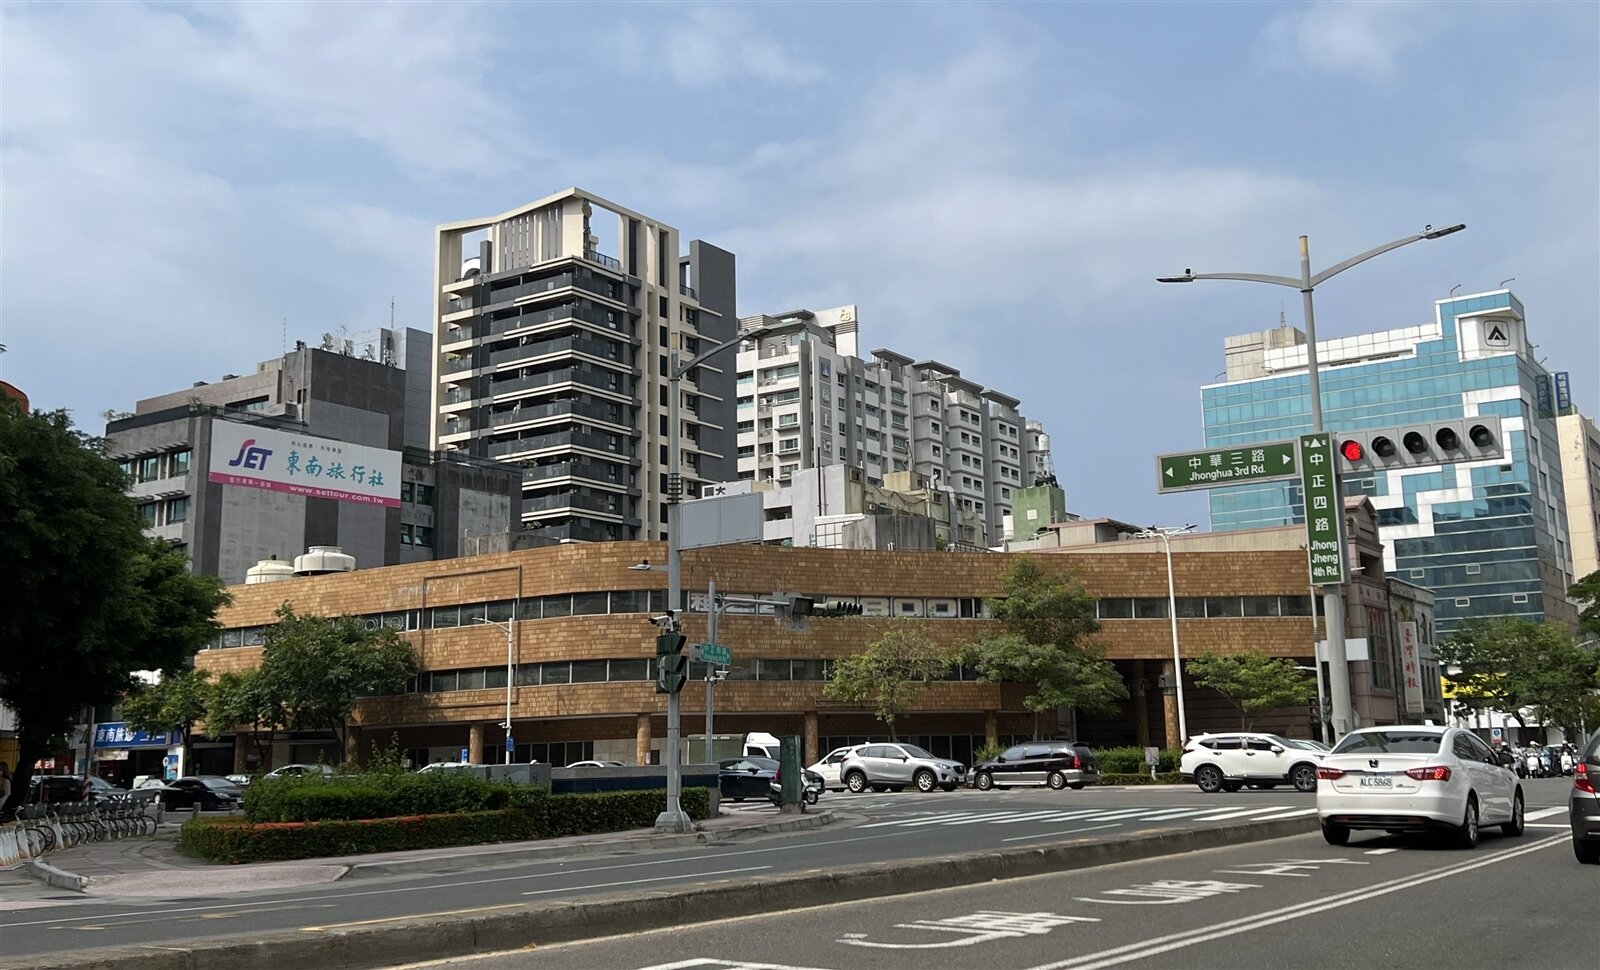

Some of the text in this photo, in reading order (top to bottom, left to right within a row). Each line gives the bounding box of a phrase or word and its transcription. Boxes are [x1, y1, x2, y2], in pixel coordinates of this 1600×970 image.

[228, 439, 273, 471] SET
[1188, 449, 1265, 469] 中華三路
[286, 450, 384, 487] 東南旅行社
[1189, 464, 1266, 481] Jhonghua 3rd Rd.
[289, 485, 384, 504] www.settour.com.tw
[1309, 452, 1329, 532] 中正四路
[1311, 540, 1337, 551] Jhong
[1312, 553, 1338, 564] Jheng
[1313, 566, 1339, 577] 4th Rd.
